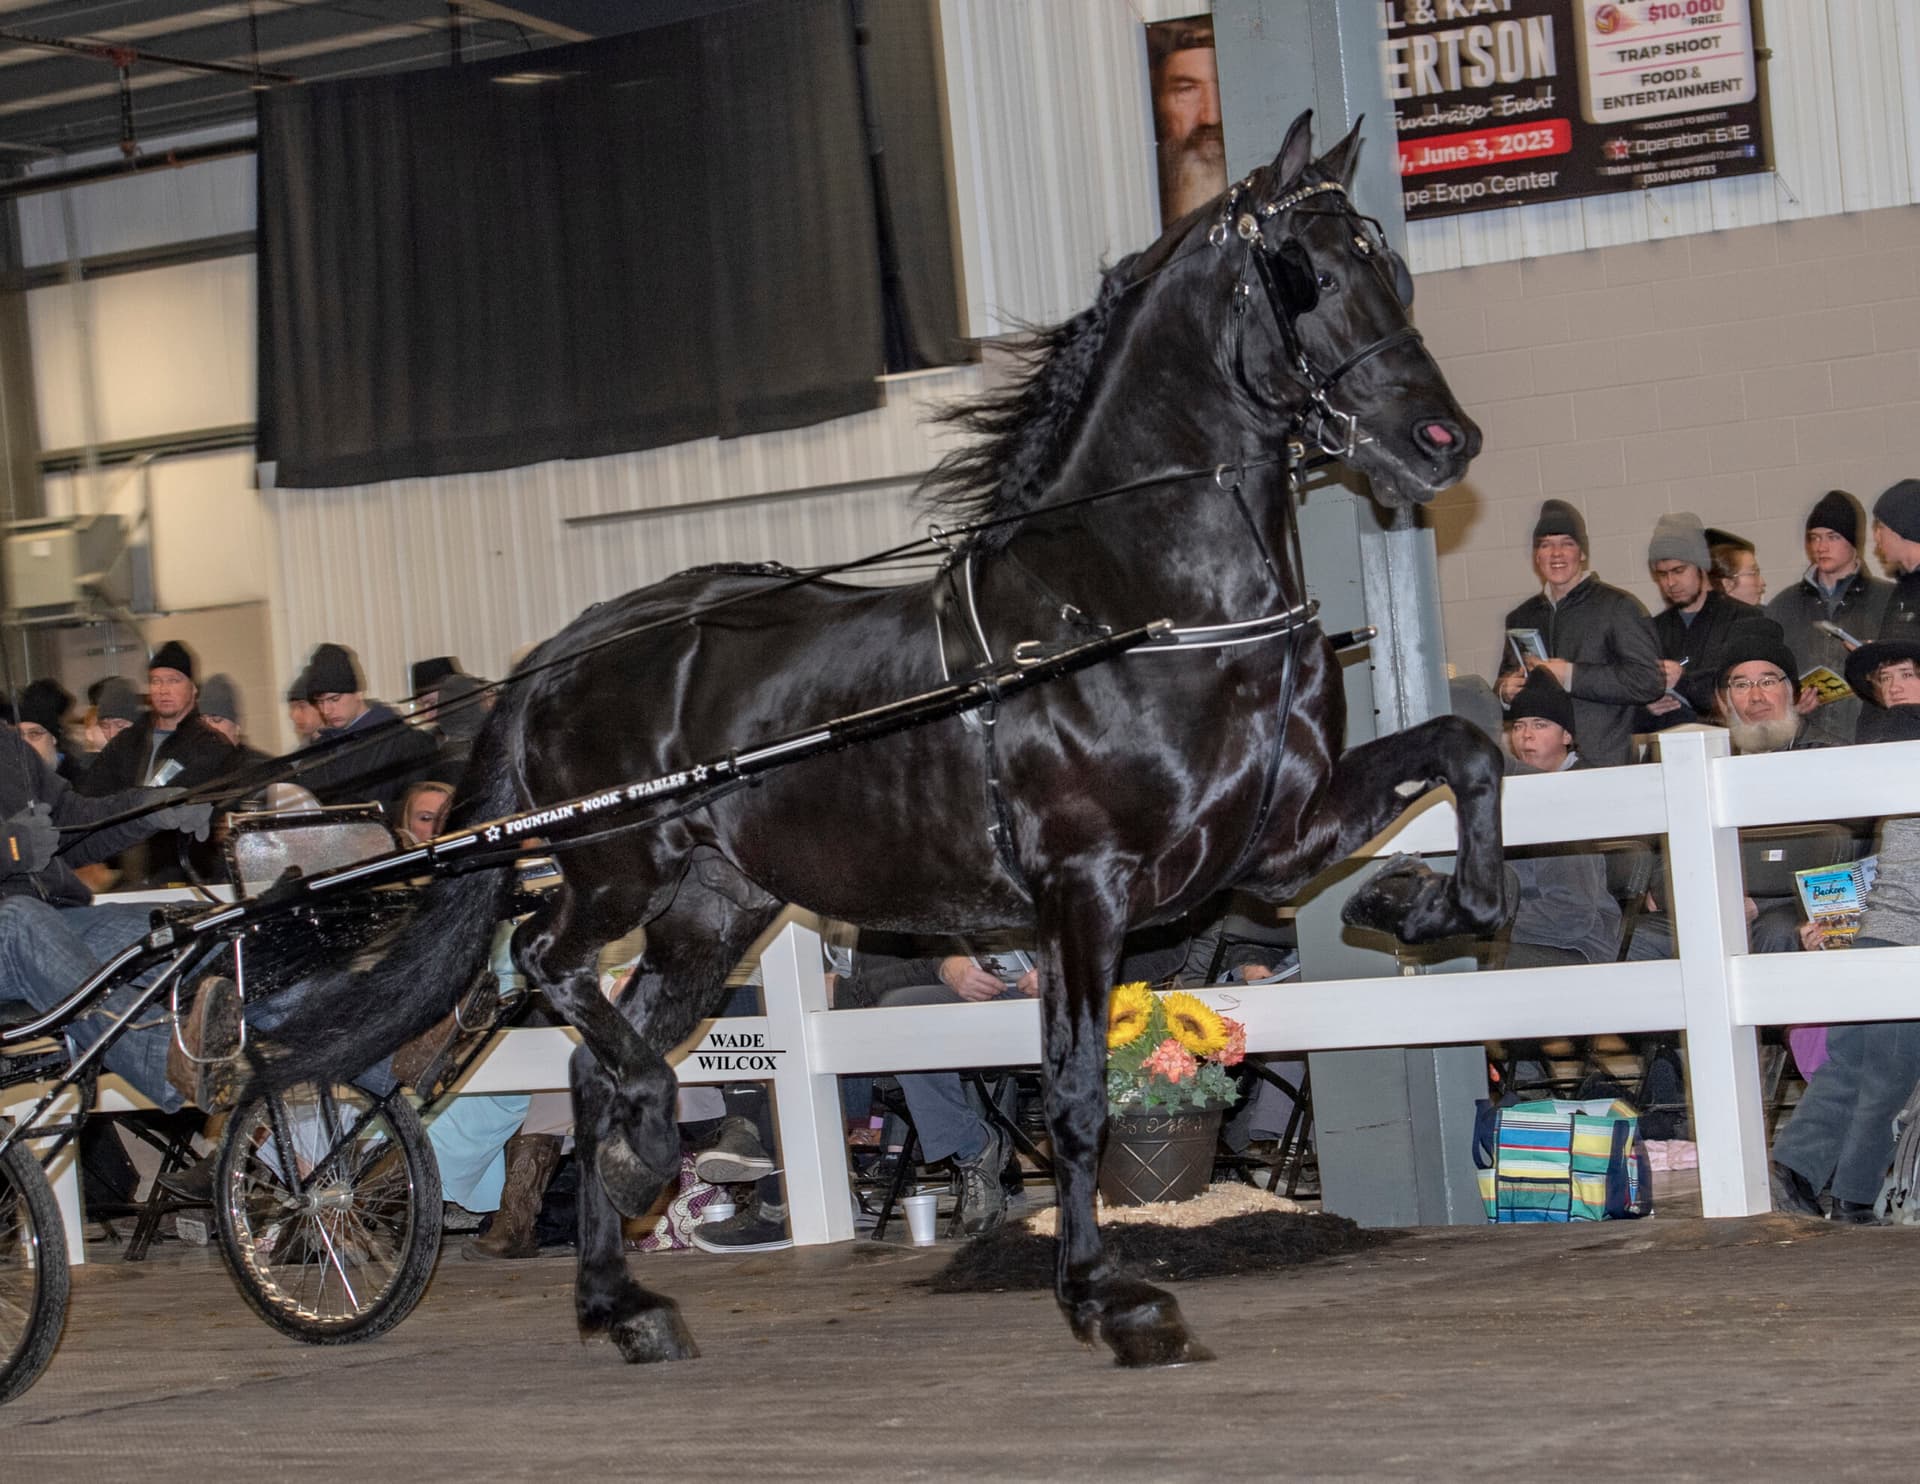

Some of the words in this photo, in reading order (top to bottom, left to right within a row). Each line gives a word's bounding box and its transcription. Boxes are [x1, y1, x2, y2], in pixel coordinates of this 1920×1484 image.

[1415, 0, 1437, 24] &
[1648, 0, 1726, 23] $10,000
[1691, 13, 1723, 26] PRIZE
[1617, 48, 1662, 63] TRAP
[1665, 36, 1721, 56] SHOOT
[1641, 69, 1687, 86] FOOD
[1691, 66, 1702, 79] &
[1501, 85, 1556, 116] Event
[1603, 78, 1743, 110] ENTERTAINMENT
[1685, 116, 1695, 125] TO
[1420, 145, 1469, 166] June
[1475, 139, 1494, 160] 3,
[1500, 129, 1554, 154] 2023
[1636, 131, 1710, 155] Operation
[1435, 182, 1486, 203] Expo
[1490, 170, 1559, 195] Center
[505, 805, 574, 835] FOUNTAIN
[581, 790, 621, 813] NOOK
[627, 772, 688, 799] STABLES
